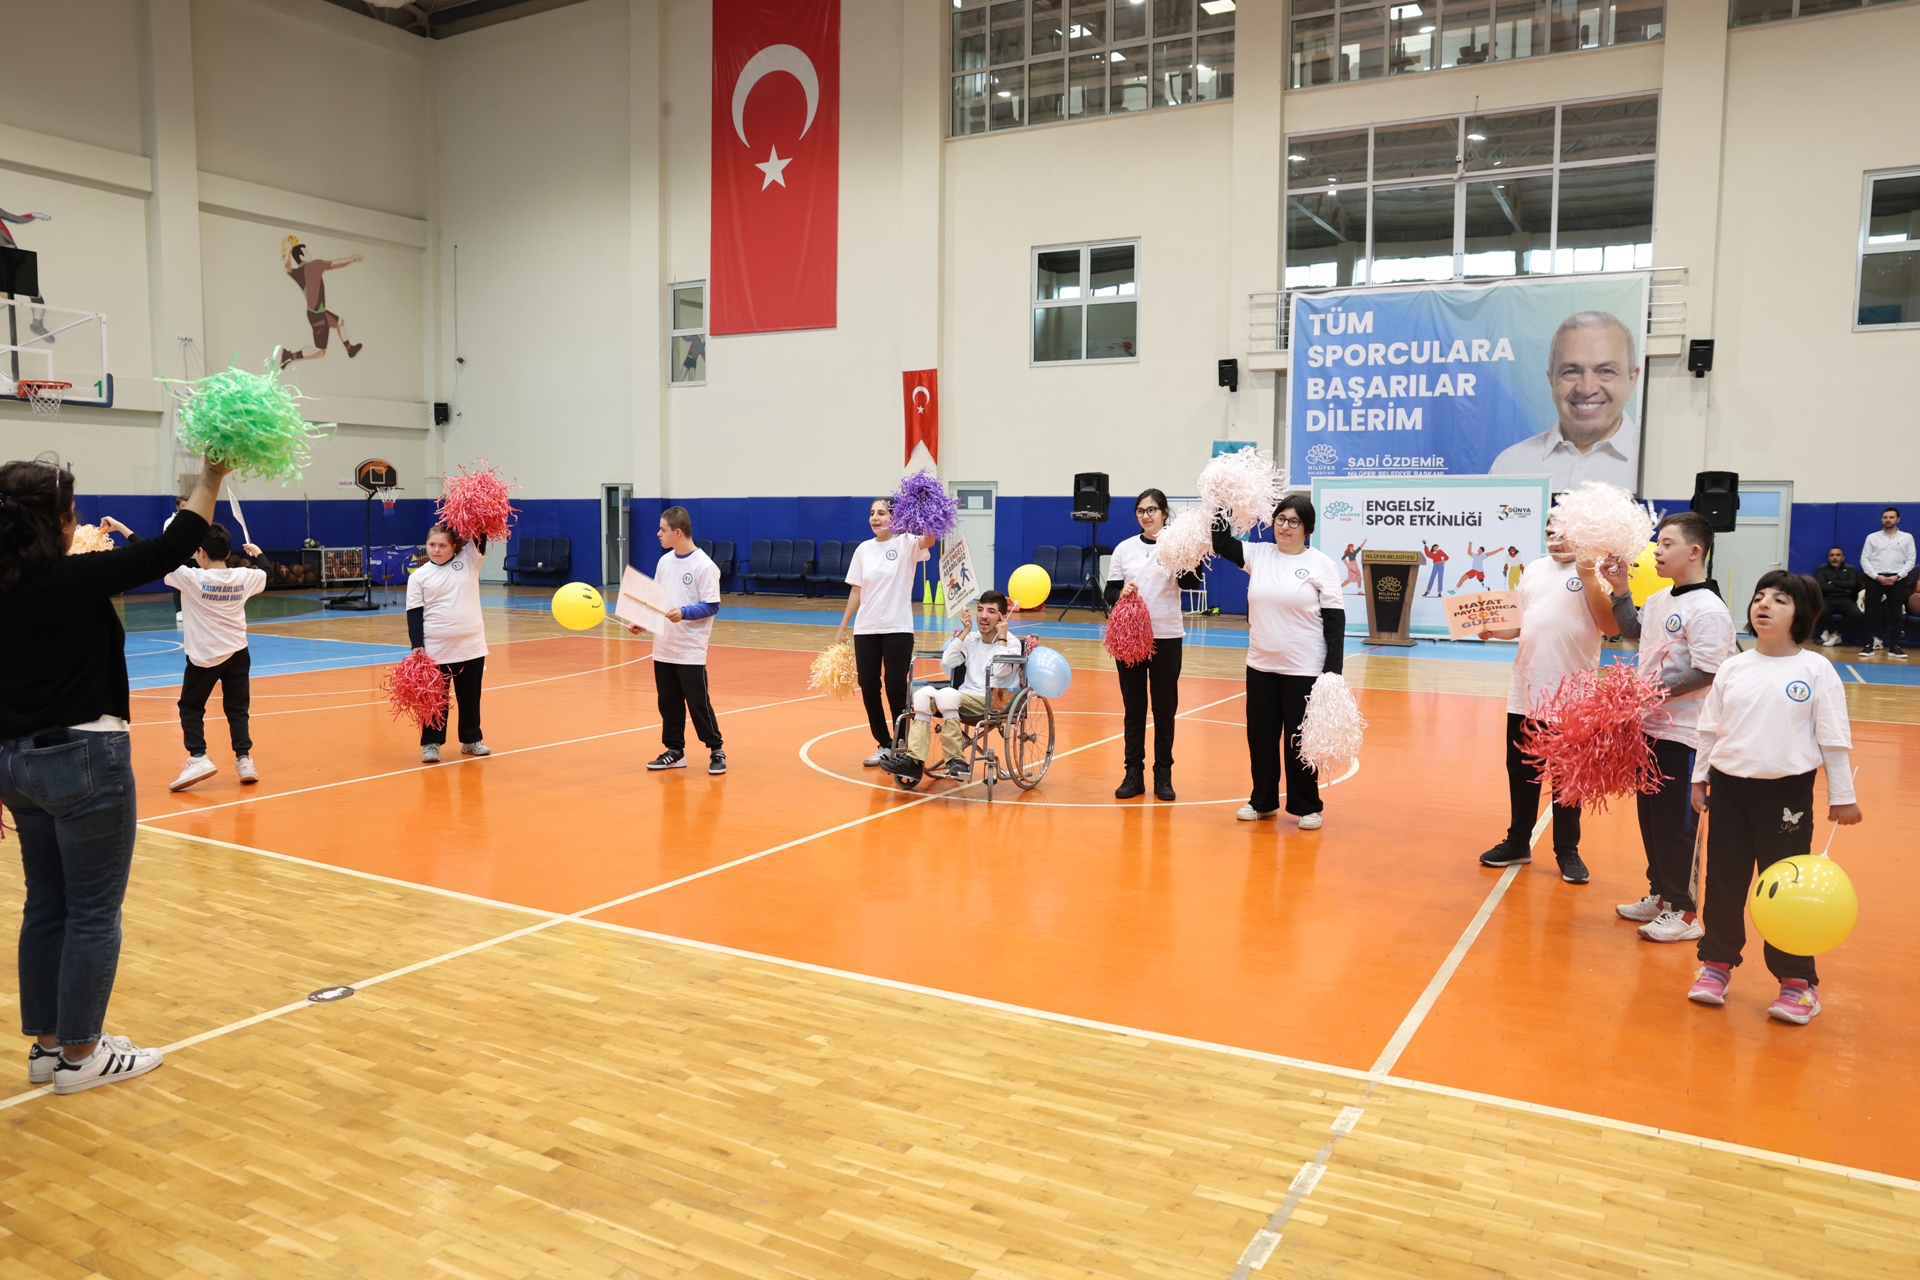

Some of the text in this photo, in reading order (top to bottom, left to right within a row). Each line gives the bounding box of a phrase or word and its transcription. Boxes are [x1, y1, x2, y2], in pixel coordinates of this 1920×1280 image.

[1309, 307, 1374, 336] TÜM
[1308, 338, 1515, 368] SPORCULARA
[94, 380, 102, 398] 1
[1307, 373, 1477, 407] BAŞARILAR
[1306, 402, 1423, 432] DİLERİM
[1348, 454, 1444, 470] ŞADİ ÖZDEMİR
[1366, 497, 1435, 512] ENGELSİZ
[1366, 511, 1482, 527] SPOR ETKİNLİĞİ
[942, 559, 951, 571] HER
[1453, 604, 1517, 617] PAYLAŞINCA
[1458, 599, 1502, 610] HAYAT
[1461, 616, 1509, 628] GÜZEL
[1467, 610, 1500, 620] ÇOK
